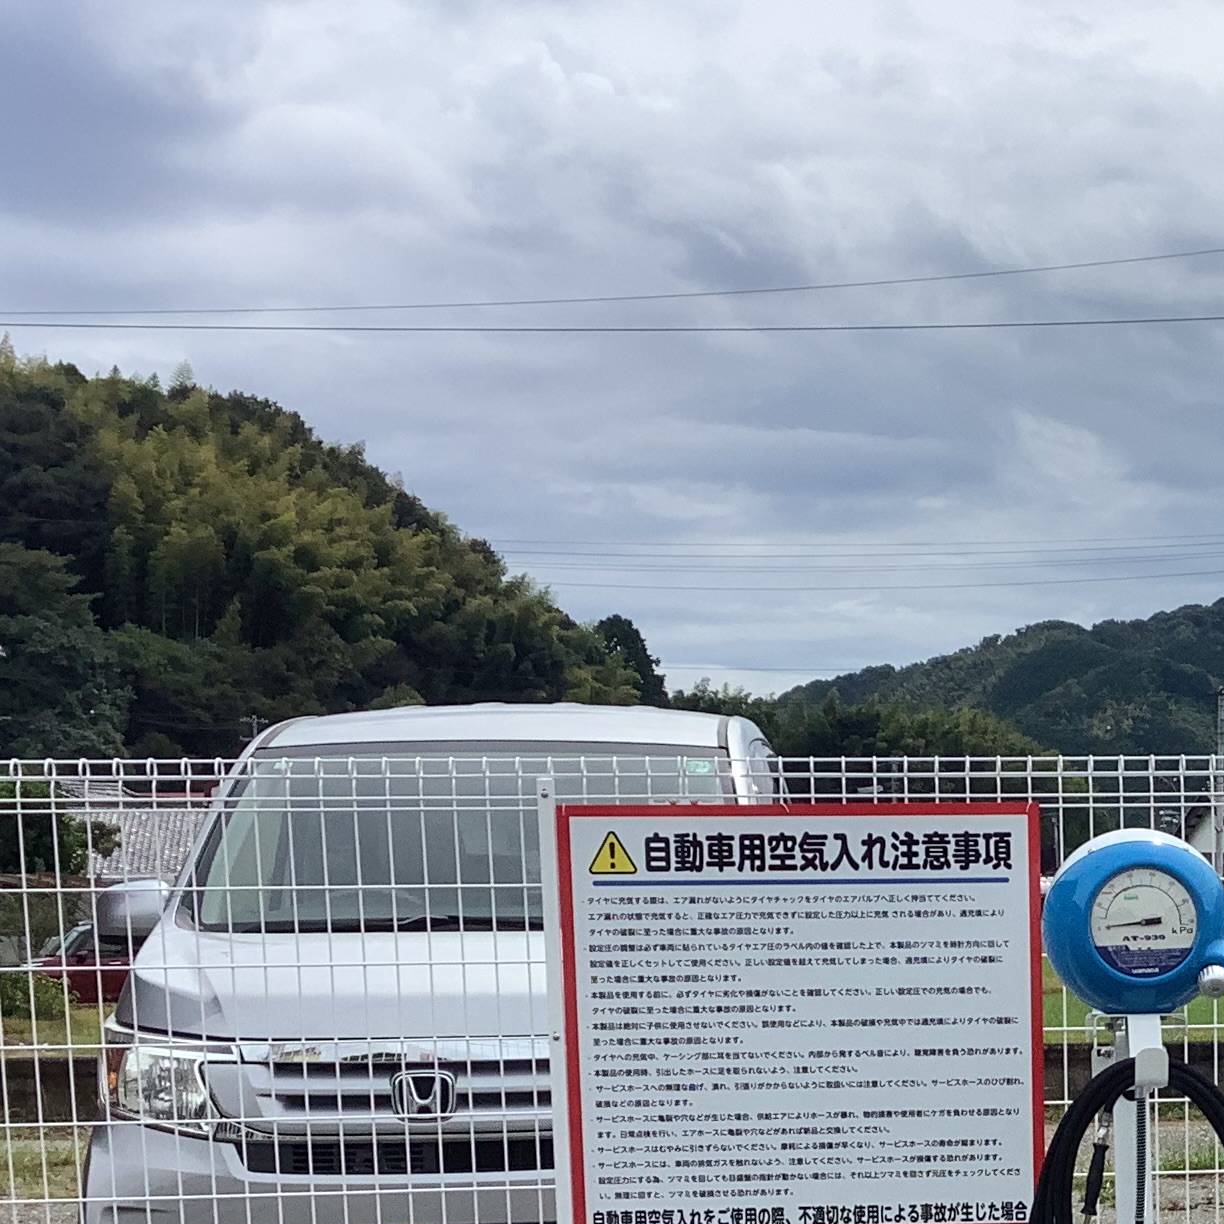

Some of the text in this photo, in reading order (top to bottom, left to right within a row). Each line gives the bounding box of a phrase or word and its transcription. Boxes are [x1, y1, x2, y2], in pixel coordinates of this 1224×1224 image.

[644, 830, 1013, 874] 自動車用空気入れ注意事項
[1122, 934, 1166, 942] AT-930
[595, 1098, 694, 1109] 破損などの原因となります。
